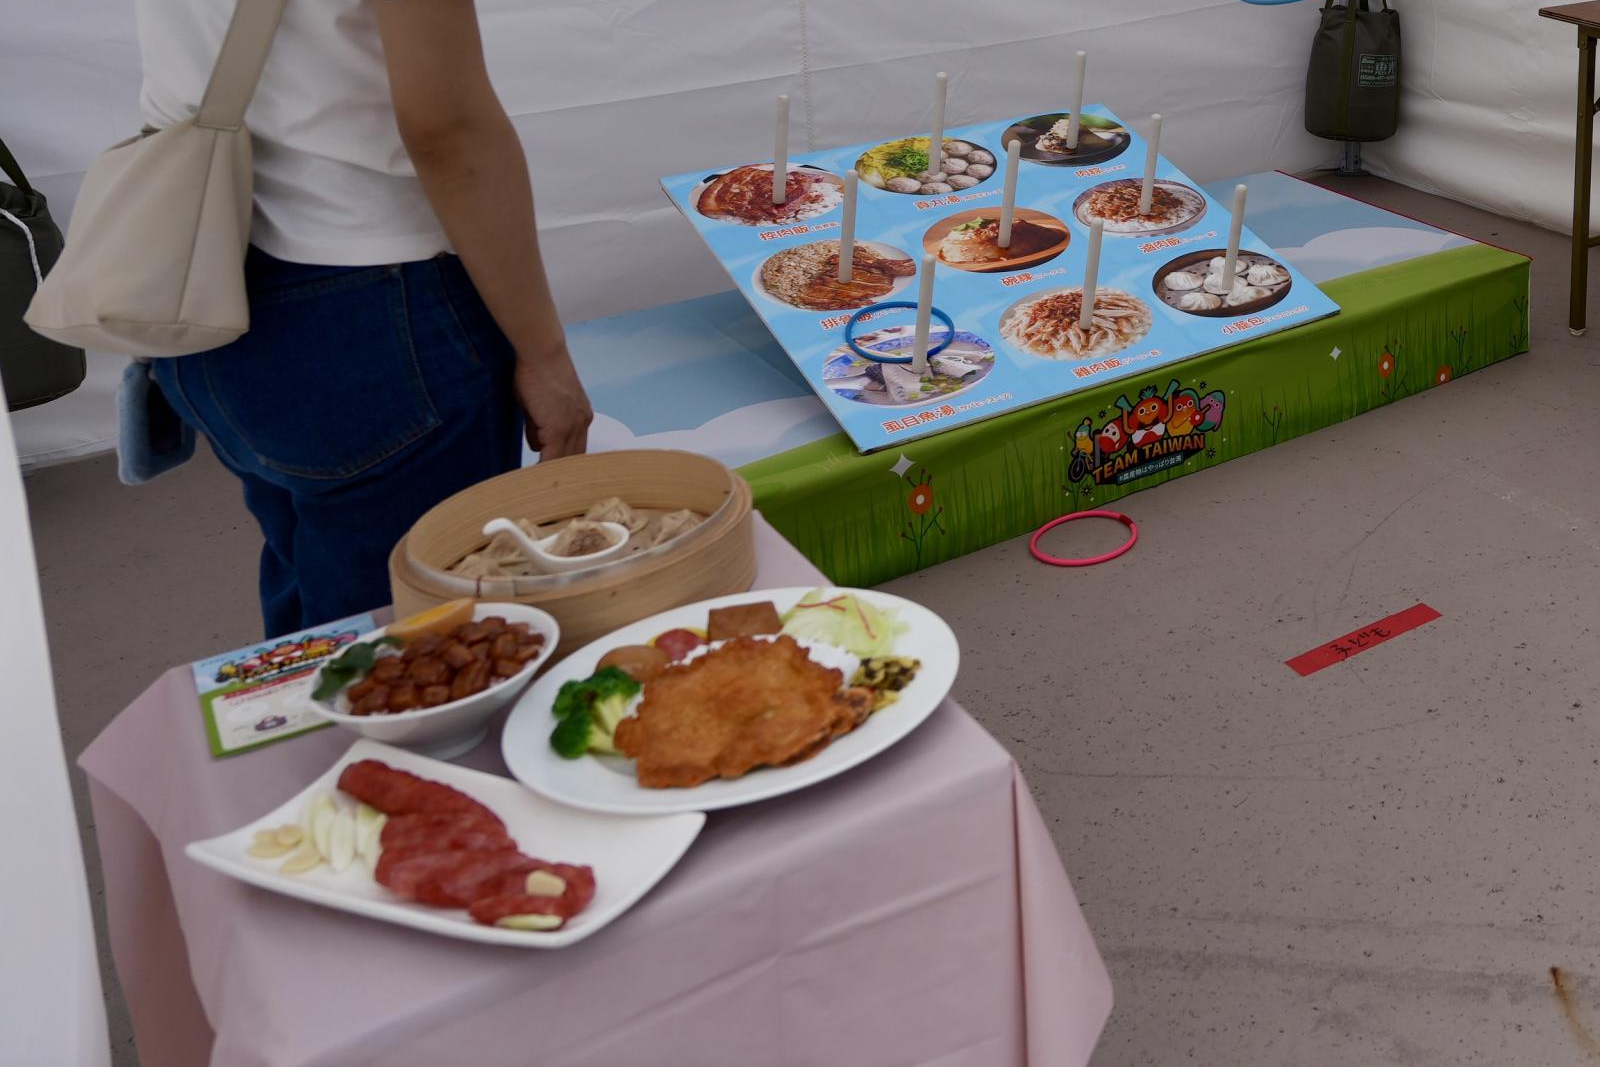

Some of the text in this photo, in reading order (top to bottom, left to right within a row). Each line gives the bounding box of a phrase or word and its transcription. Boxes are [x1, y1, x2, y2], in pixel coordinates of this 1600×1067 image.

[1092, 434, 1205, 484] TEAM TAIWAN
[1331, 627, 1391, 661] 子ども
